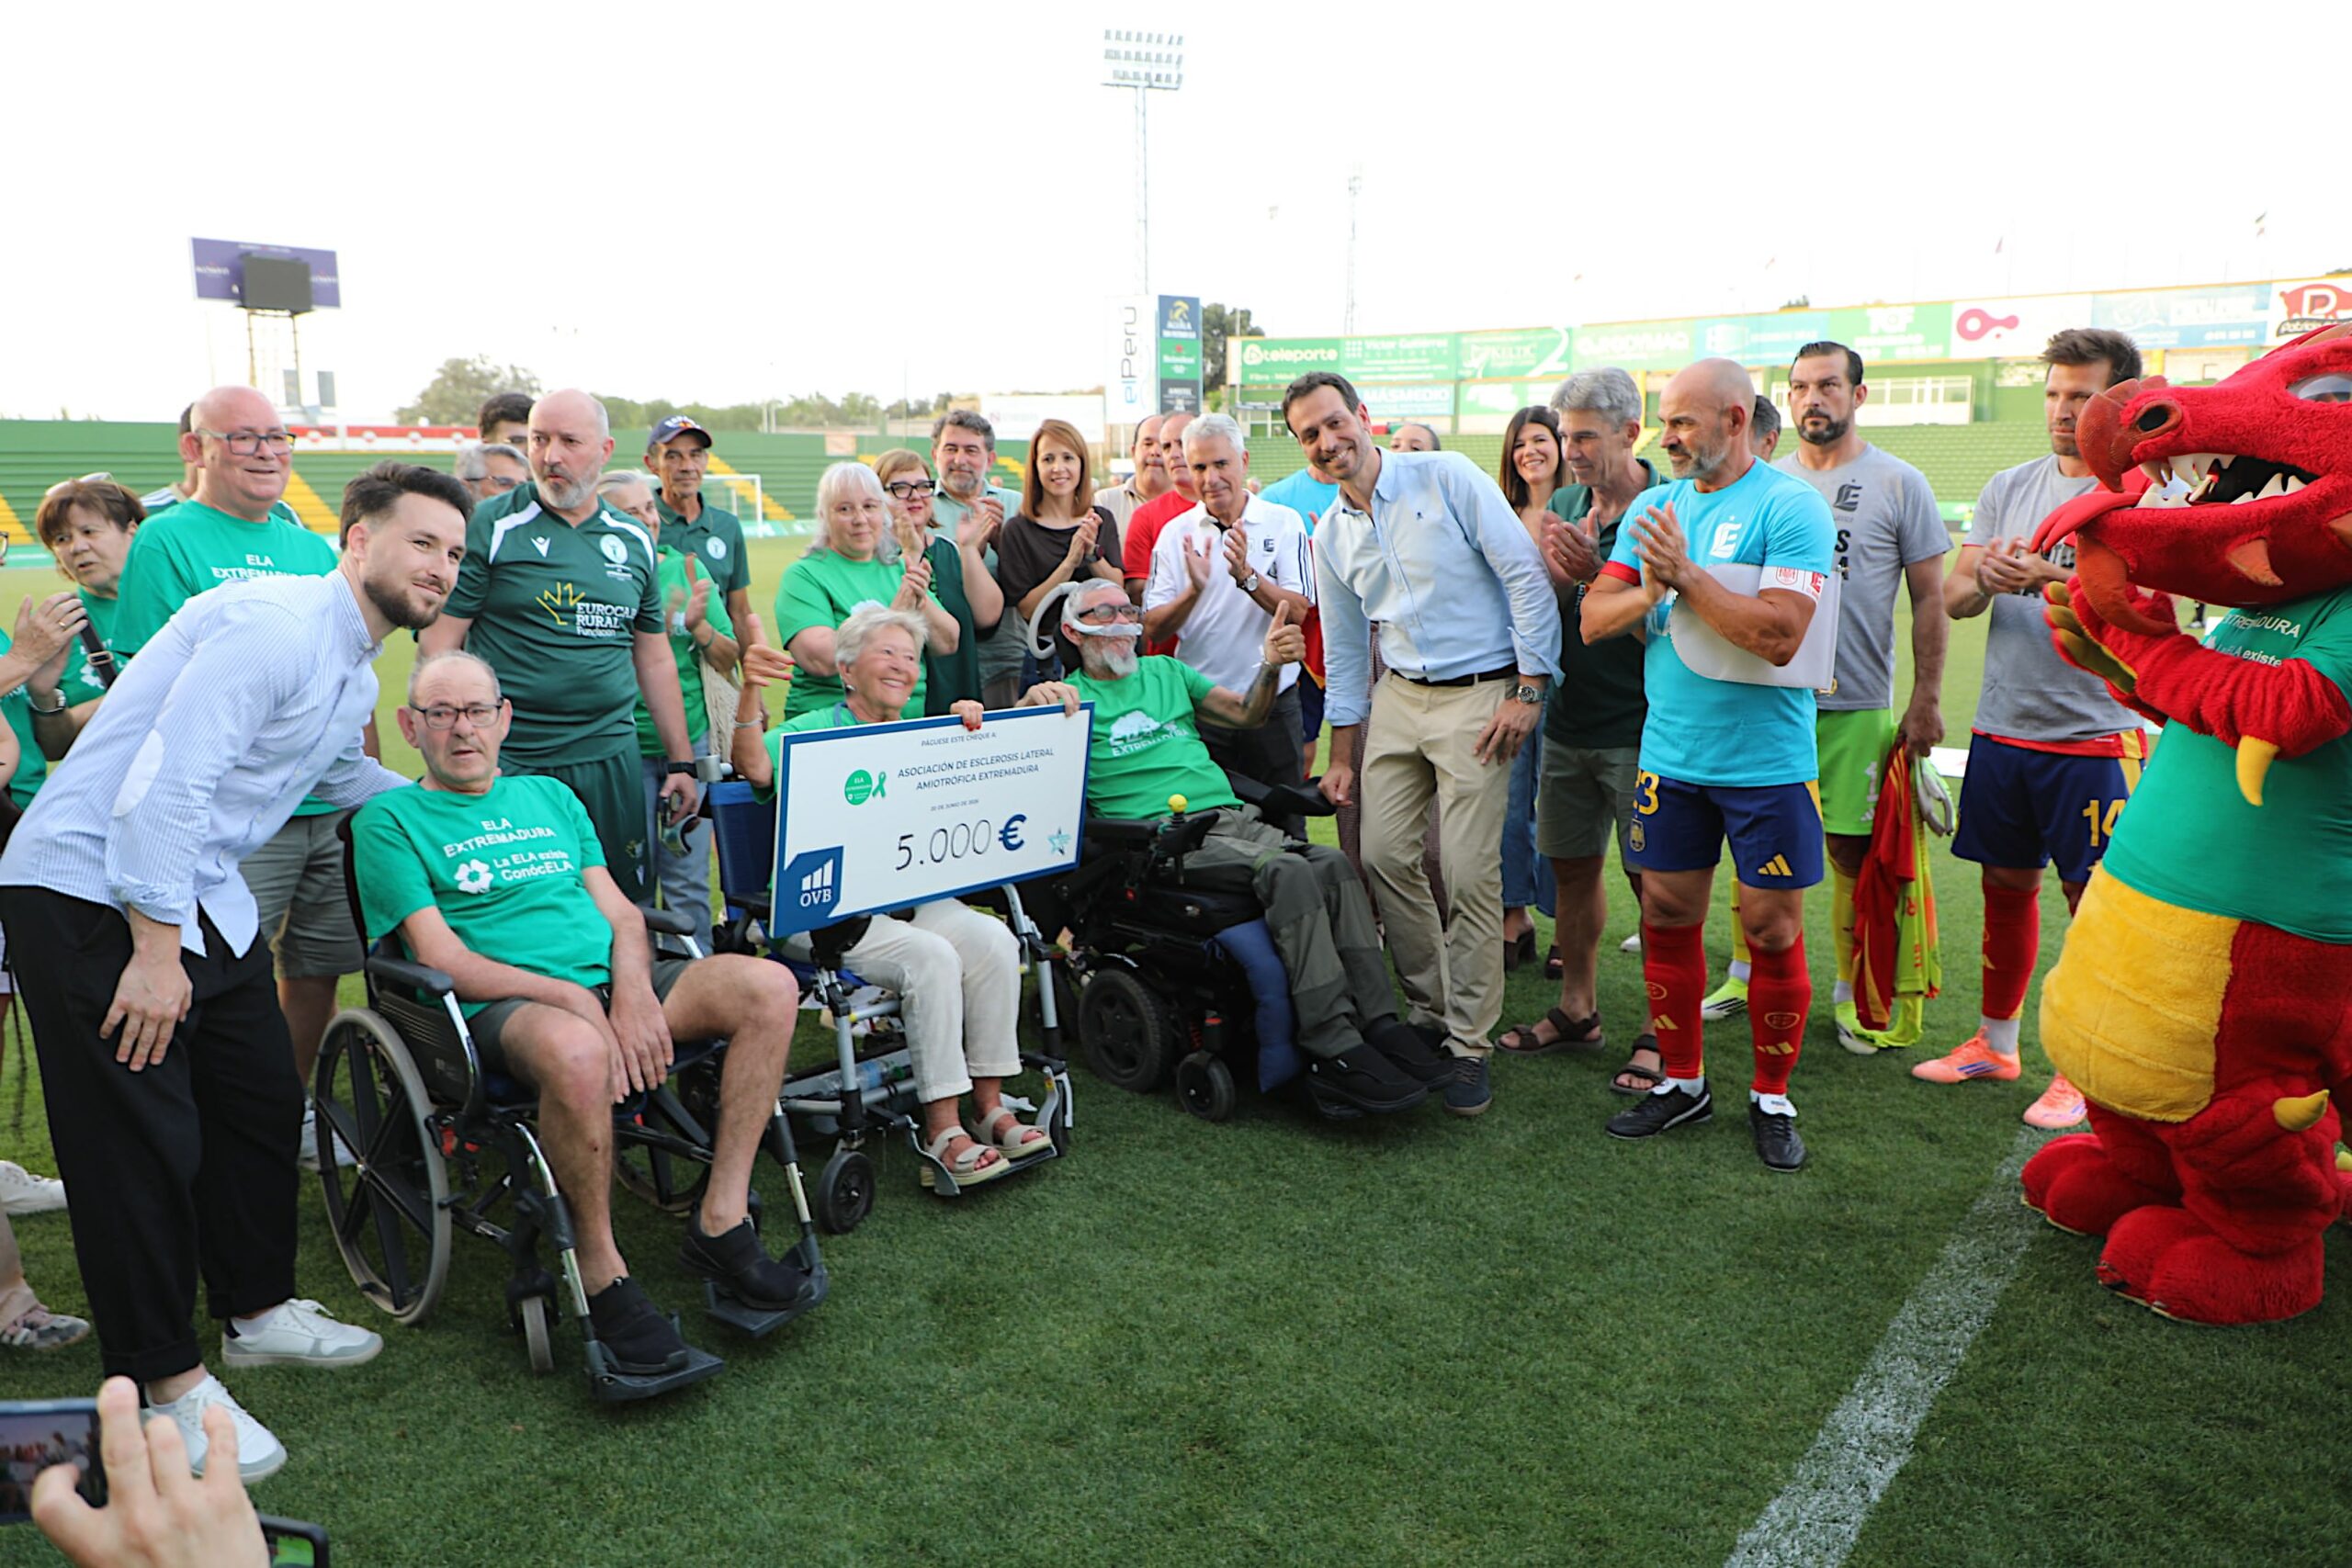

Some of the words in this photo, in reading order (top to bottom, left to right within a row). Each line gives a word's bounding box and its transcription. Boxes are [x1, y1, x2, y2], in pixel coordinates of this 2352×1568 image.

[1263, 348, 1338, 364] teleporte
[245, 553, 275, 568] ELA
[575, 614, 620, 629] RURAL
[950, 735, 965, 745] ESTE
[898, 761, 955, 778] ASOCIACIÓN
[956, 760, 967, 770] DE
[969, 752, 1019, 768] ESCLEROSIS
[1020, 748, 1055, 761] LATERAL
[978, 764, 1040, 781] EXTREMADURA
[1633, 769, 1659, 816] 3
[481, 818, 513, 831] ELA
[443, 827, 557, 858] EXTREMADURA
[895, 819, 991, 871] 5.000
[998, 813, 1027, 852] €
[493, 858, 511, 869] La
[512, 852, 537, 865] ELA
[501, 861, 574, 882] ConócELA
[800, 888, 831, 908] OVB
